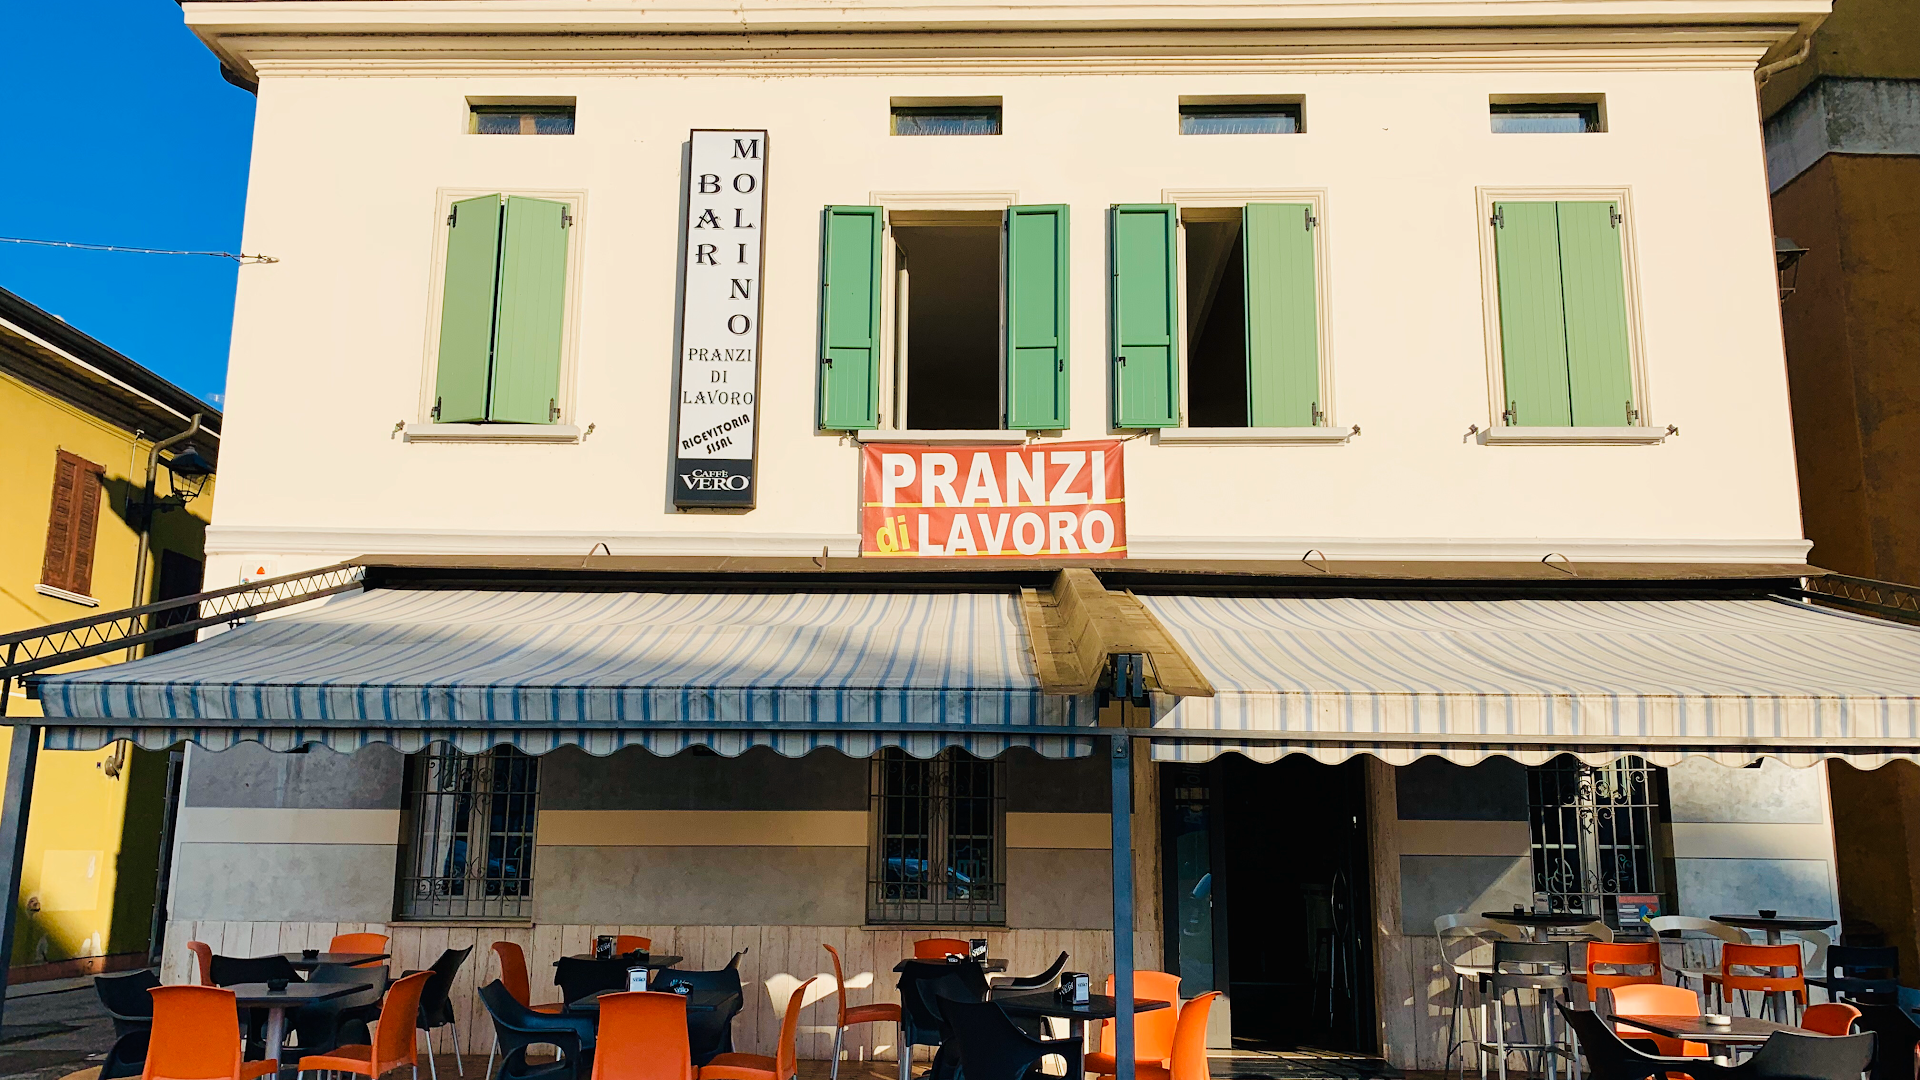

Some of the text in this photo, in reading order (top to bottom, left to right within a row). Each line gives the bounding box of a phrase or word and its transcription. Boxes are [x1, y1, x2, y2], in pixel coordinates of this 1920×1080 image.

[693, 173, 724, 266] BAR
[727, 138, 761, 336] MOLINO
[688, 347, 752, 362] PRANZI
[711, 370, 728, 383] DI
[683, 389, 753, 405] LAVORO
[681, 413, 751, 450] RICEVITORIA
[706, 435, 733, 455] SISAL
[680, 474, 750, 491] VERO
[881, 450, 1106, 507] PRANZI
[875, 509, 1115, 556] di LAVORO
